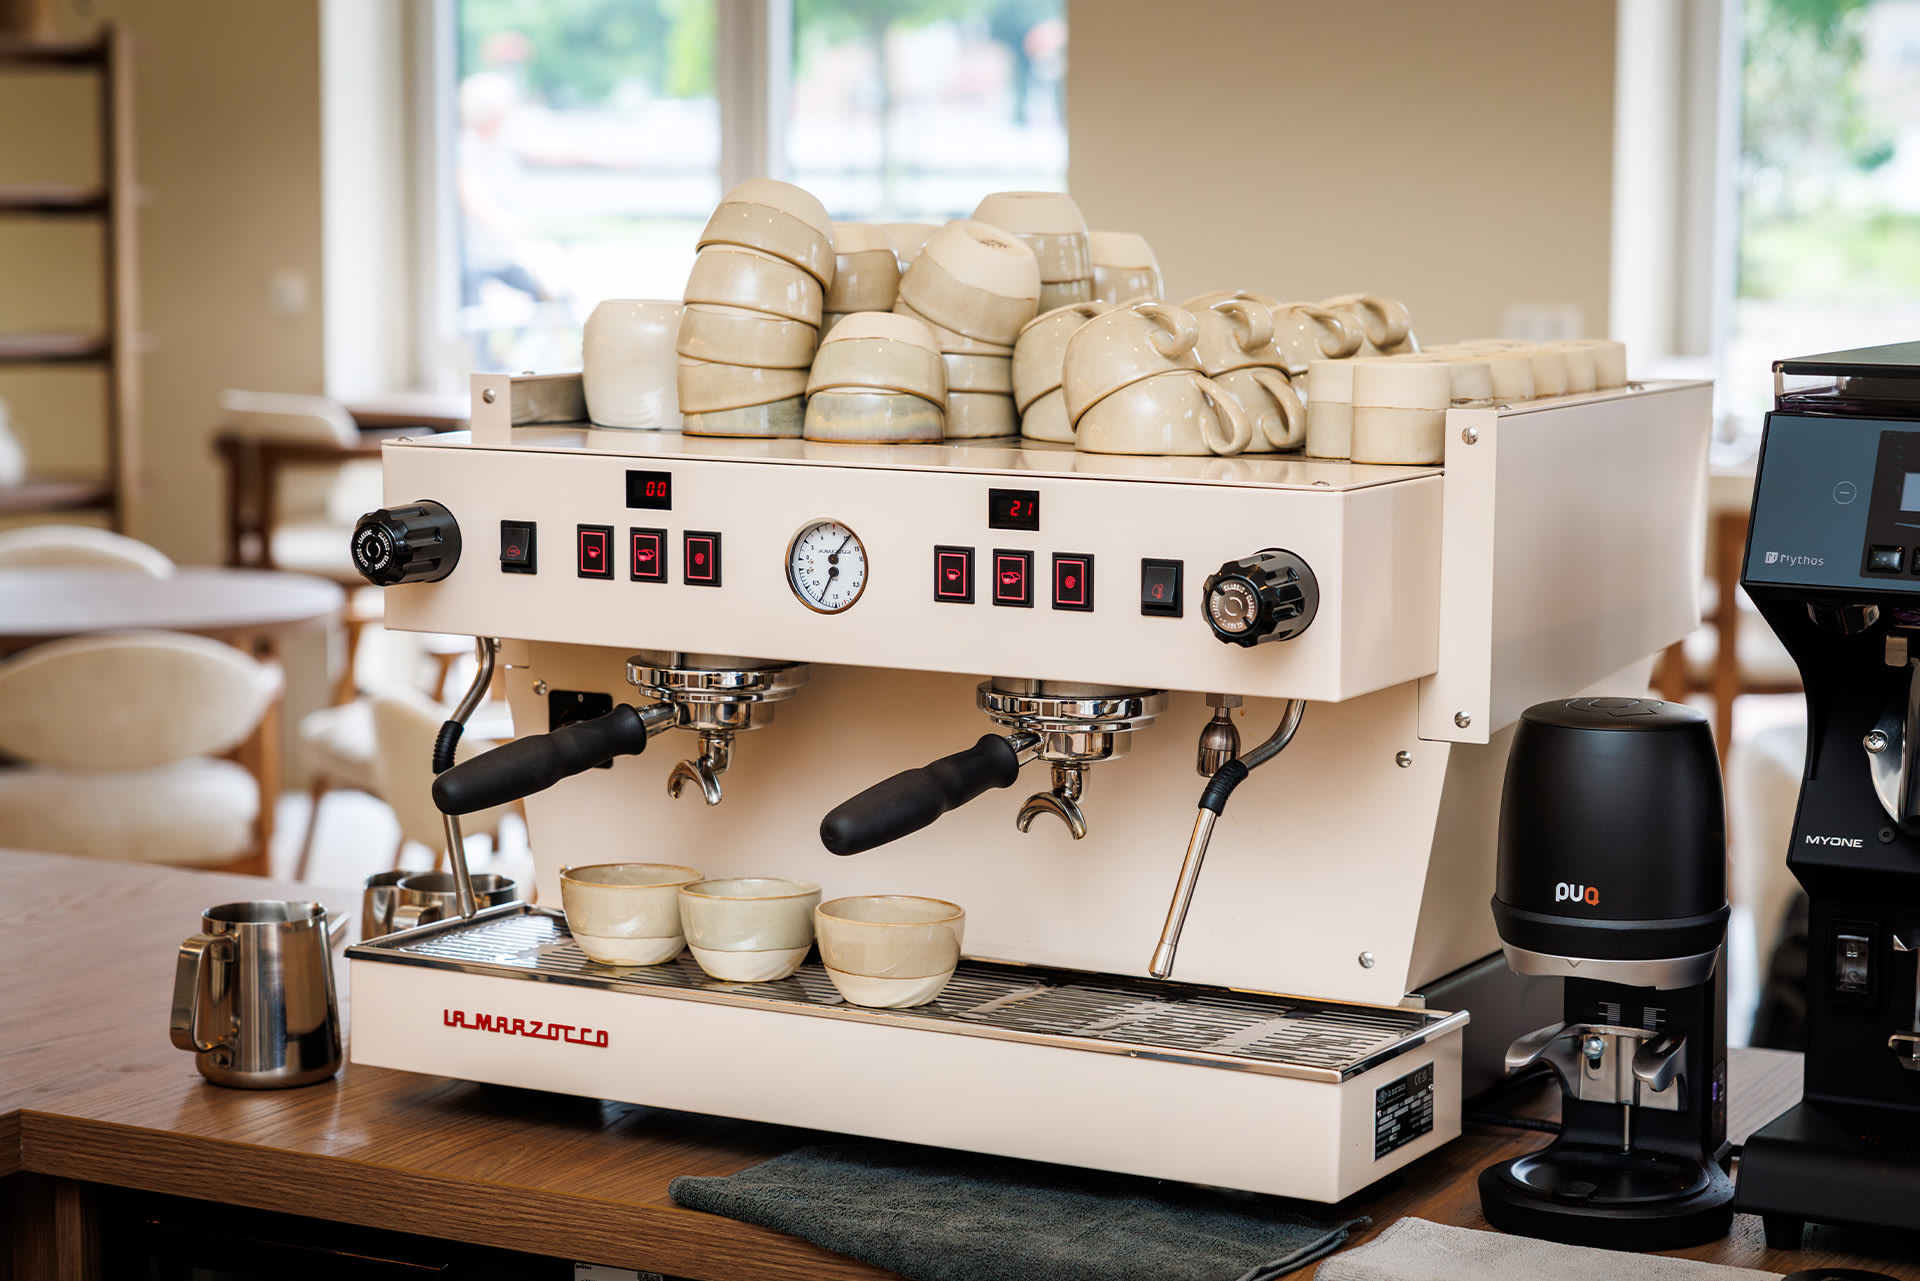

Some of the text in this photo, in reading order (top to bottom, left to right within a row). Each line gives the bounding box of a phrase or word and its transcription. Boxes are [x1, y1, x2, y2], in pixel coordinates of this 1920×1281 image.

[646, 481, 667, 497] 00
[1010, 500, 1033, 517] 21
[1805, 835, 1863, 849] MYONE
